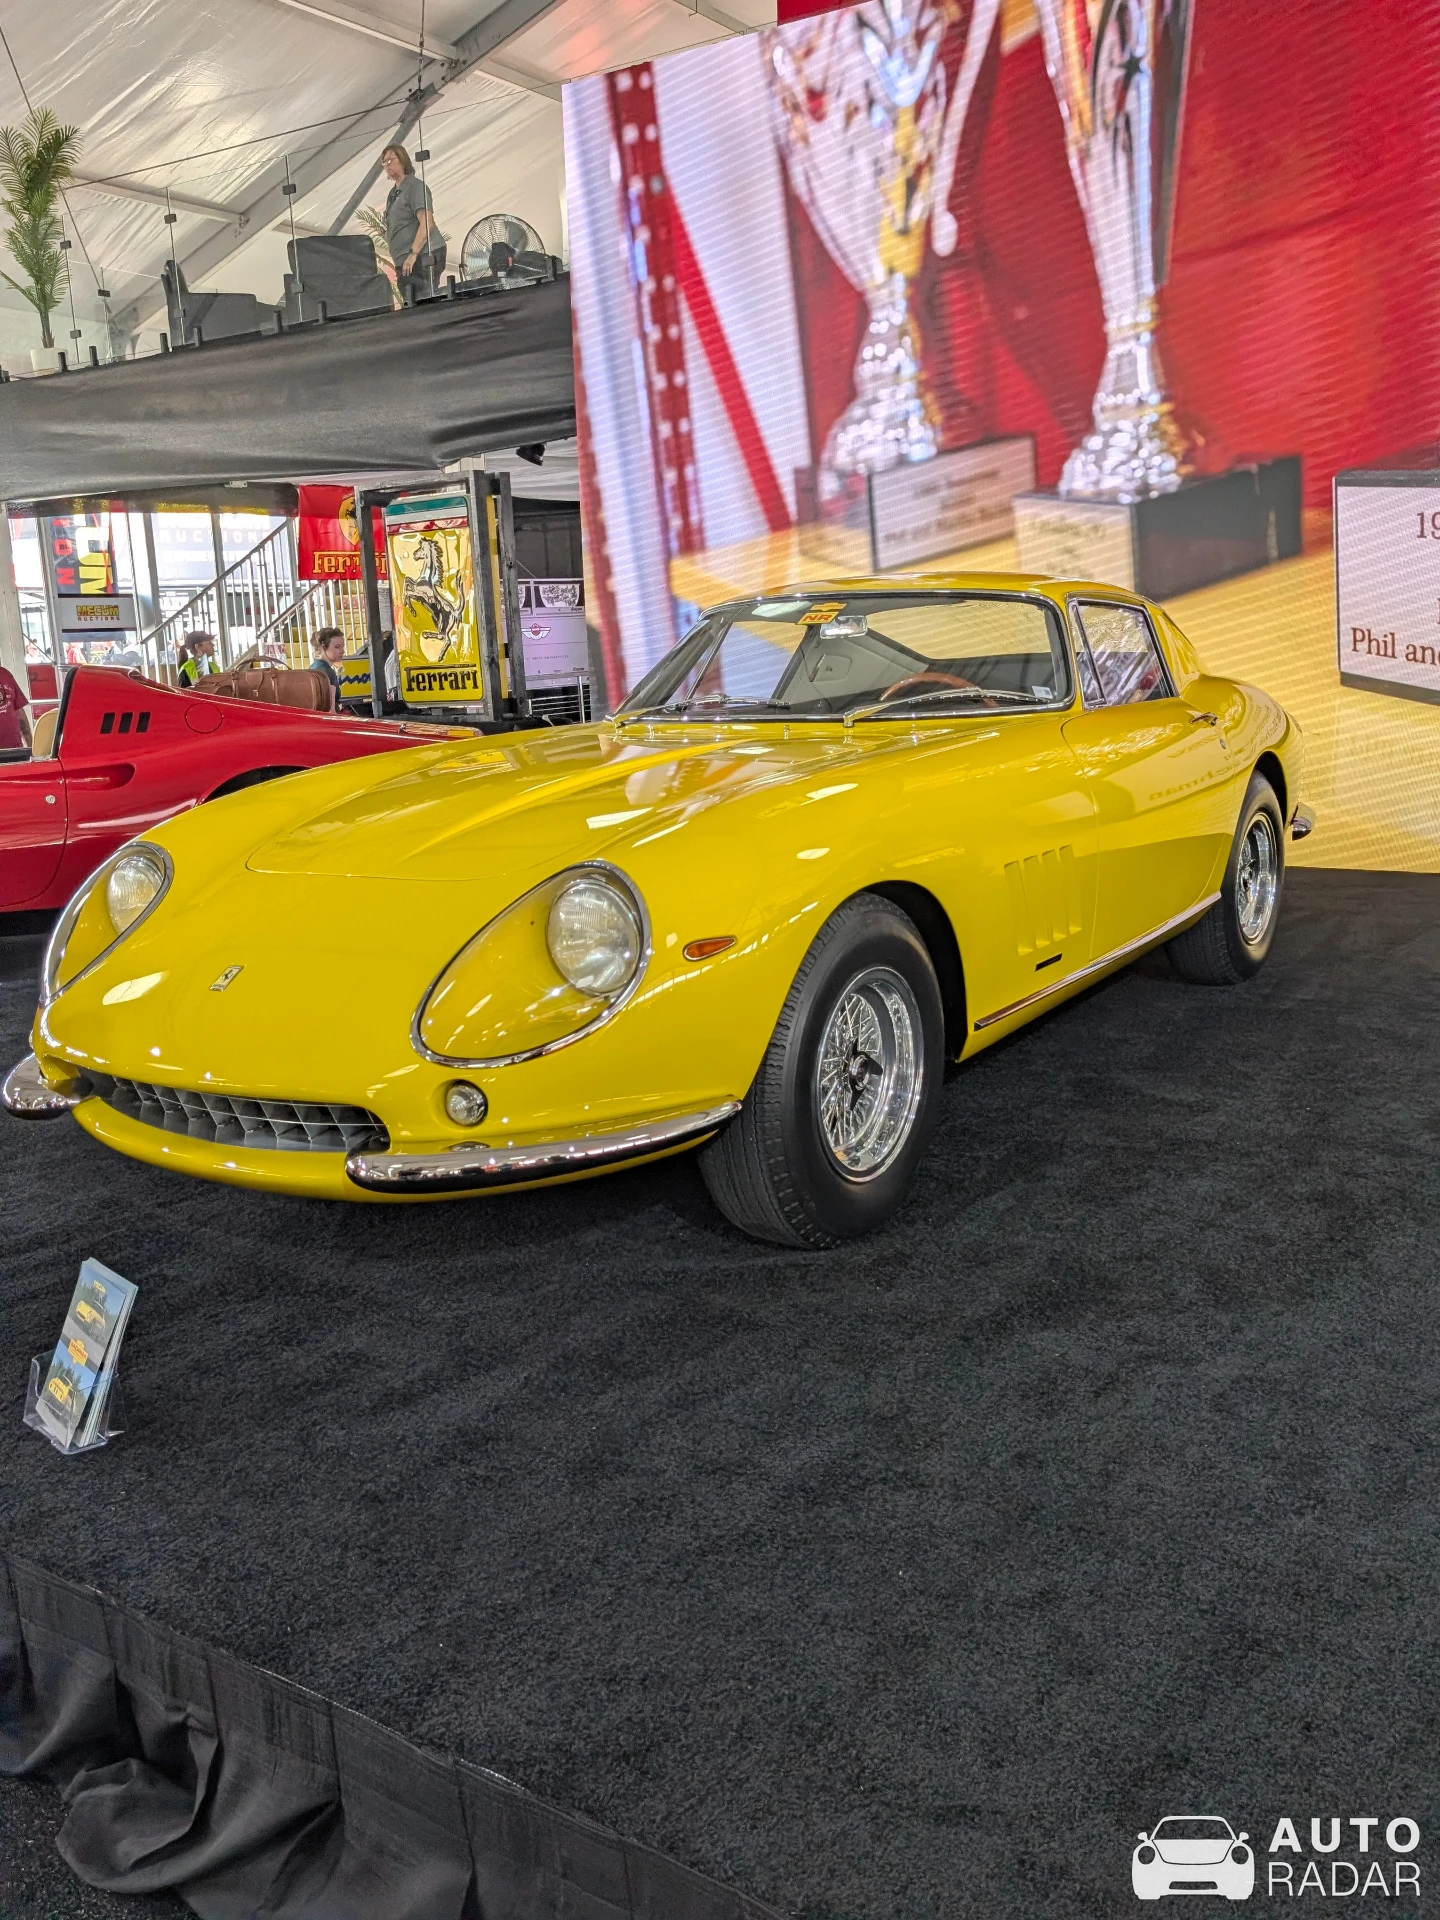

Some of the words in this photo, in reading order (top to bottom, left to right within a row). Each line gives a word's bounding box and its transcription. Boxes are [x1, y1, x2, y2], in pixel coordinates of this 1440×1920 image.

[160, 529, 272, 543] AUCION
[76, 605, 119, 616] MECUM
[1351, 627, 1397, 659] Phil
[1405, 643, 1440, 666] an
[404, 663, 479, 692] Ferrari
